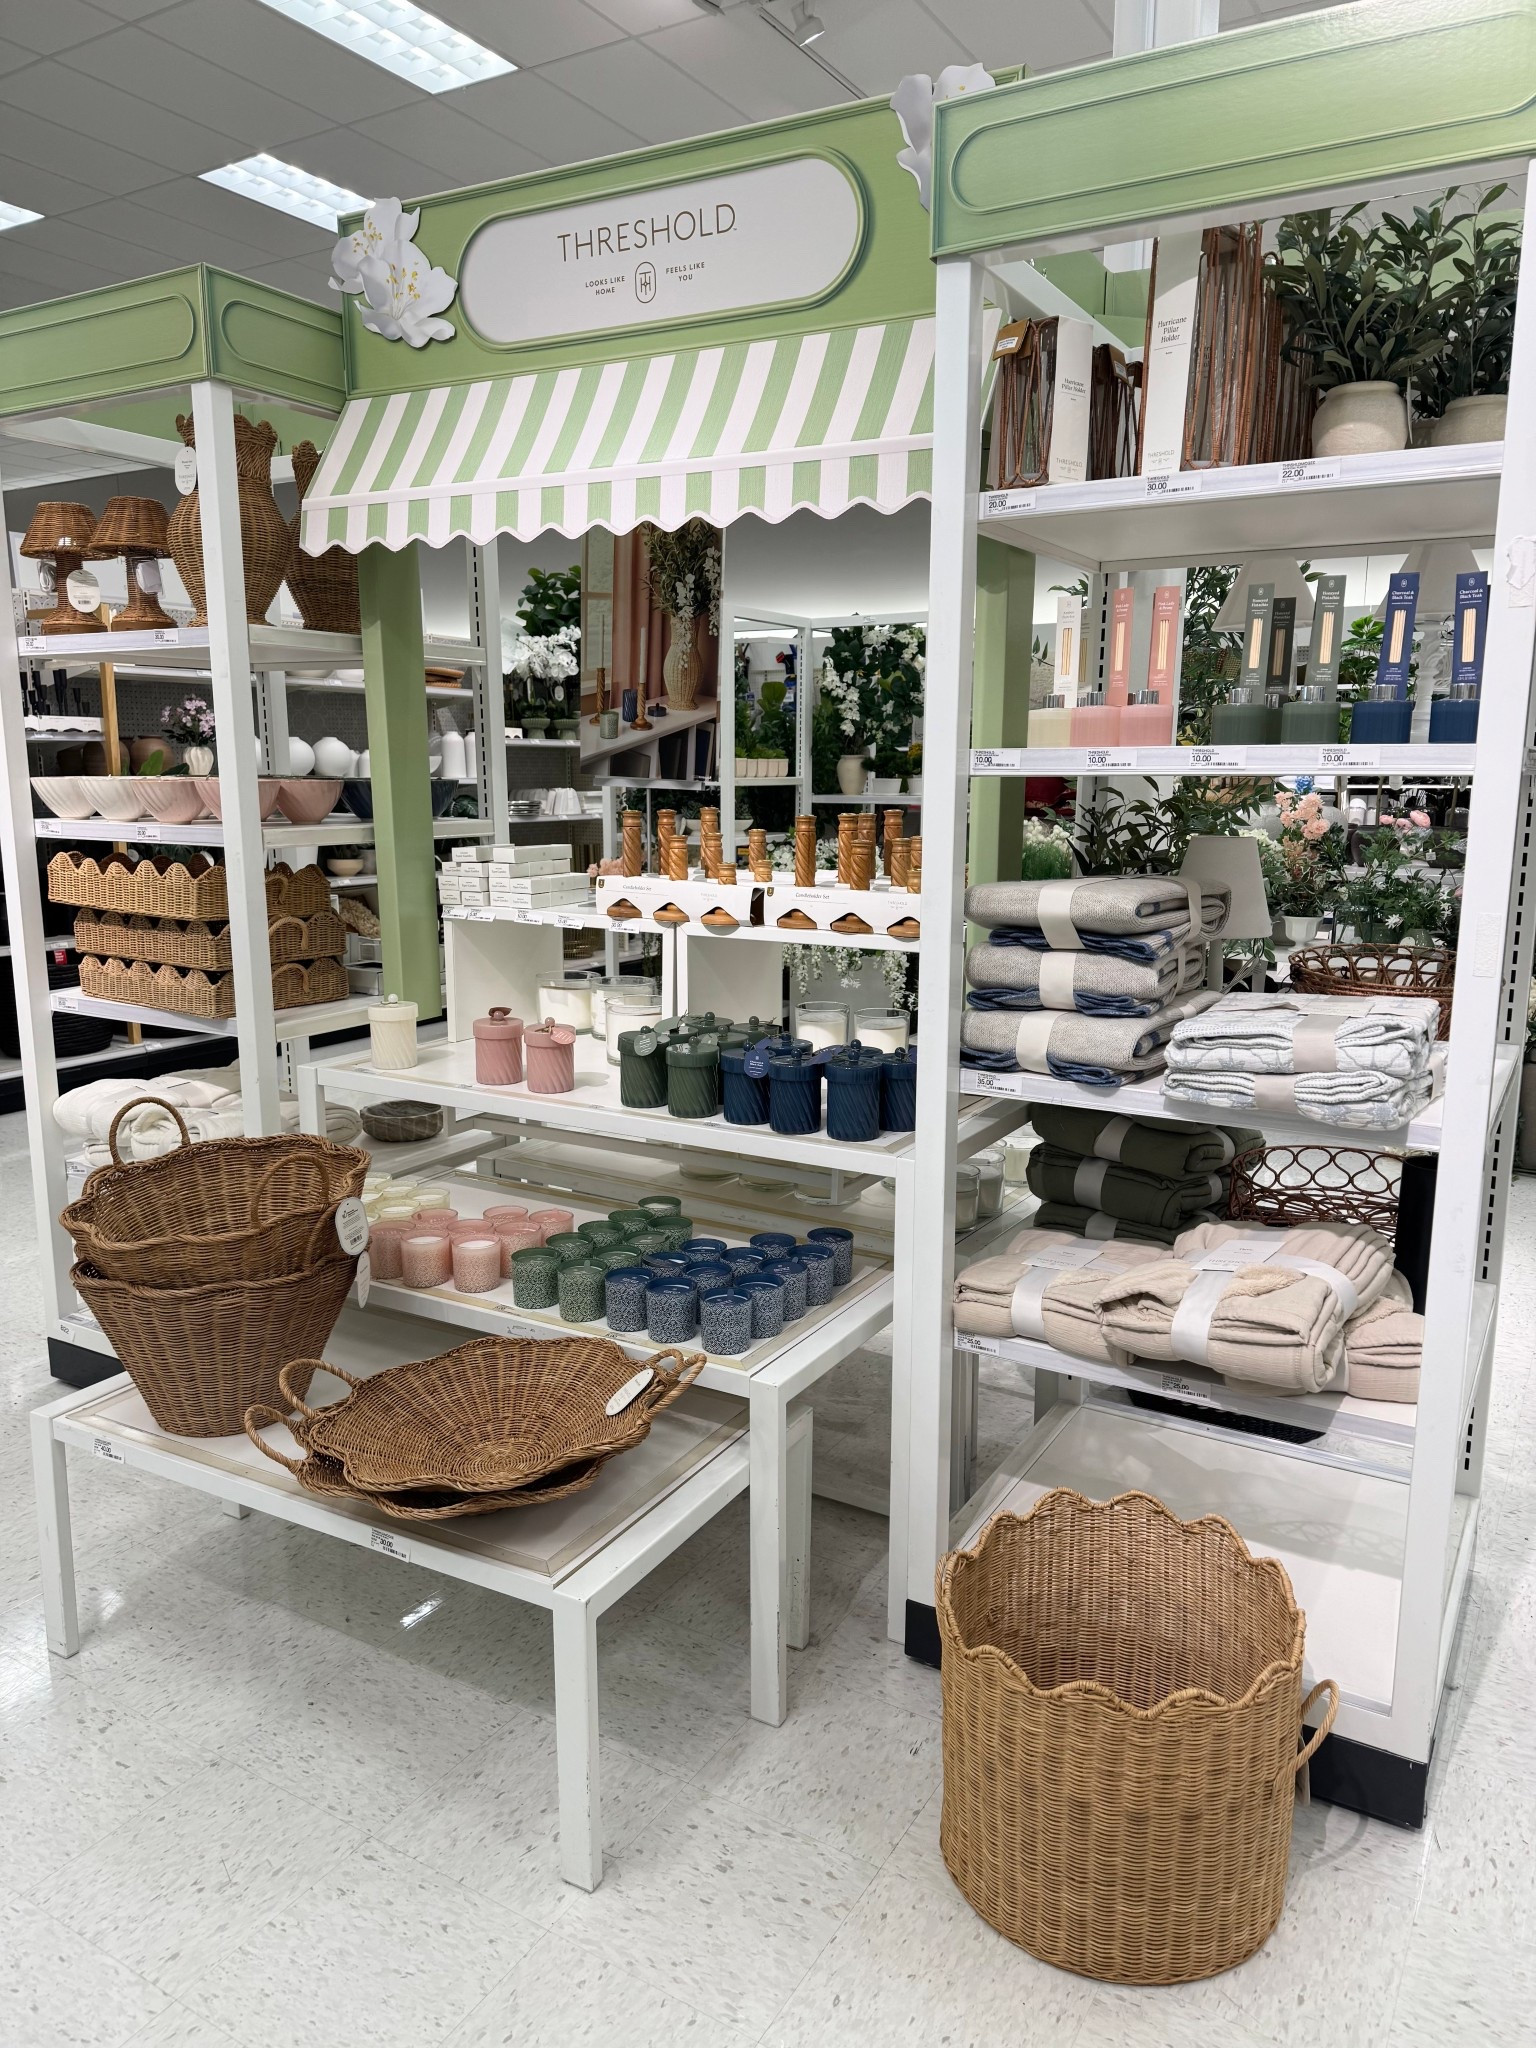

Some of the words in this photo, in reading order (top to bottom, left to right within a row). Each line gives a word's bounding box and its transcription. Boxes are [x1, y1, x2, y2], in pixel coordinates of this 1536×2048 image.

[557, 203, 736, 262] THRESHOLD
[665, 264, 687, 274] FEELS
[689, 261, 705, 270] LIKE
[585, 278, 608, 289] LOOKS
[610, 275, 626, 285] LIKE
[678, 273, 693, 282] YOU
[595, 286, 615, 295] HOME
[1157, 316, 1187, 328] Hurricane
[1163, 326, 1180, 334] Pillar
[1160, 334, 1181, 343] Holder
[1282, 468, 1304, 479] 22.00
[1147, 481, 1167, 491] 30.00
[988, 499, 1007, 509] 20.00
[1088, 756, 1106, 764] 10.00
[1192, 754, 1212, 762] 10.00
[1323, 754, 1344, 762] 10.00
[967, 1338, 981, 1346] 25.00
[1173, 1382, 1190, 1391] 25.00
[379, 1538, 394, 1549] 30.00
